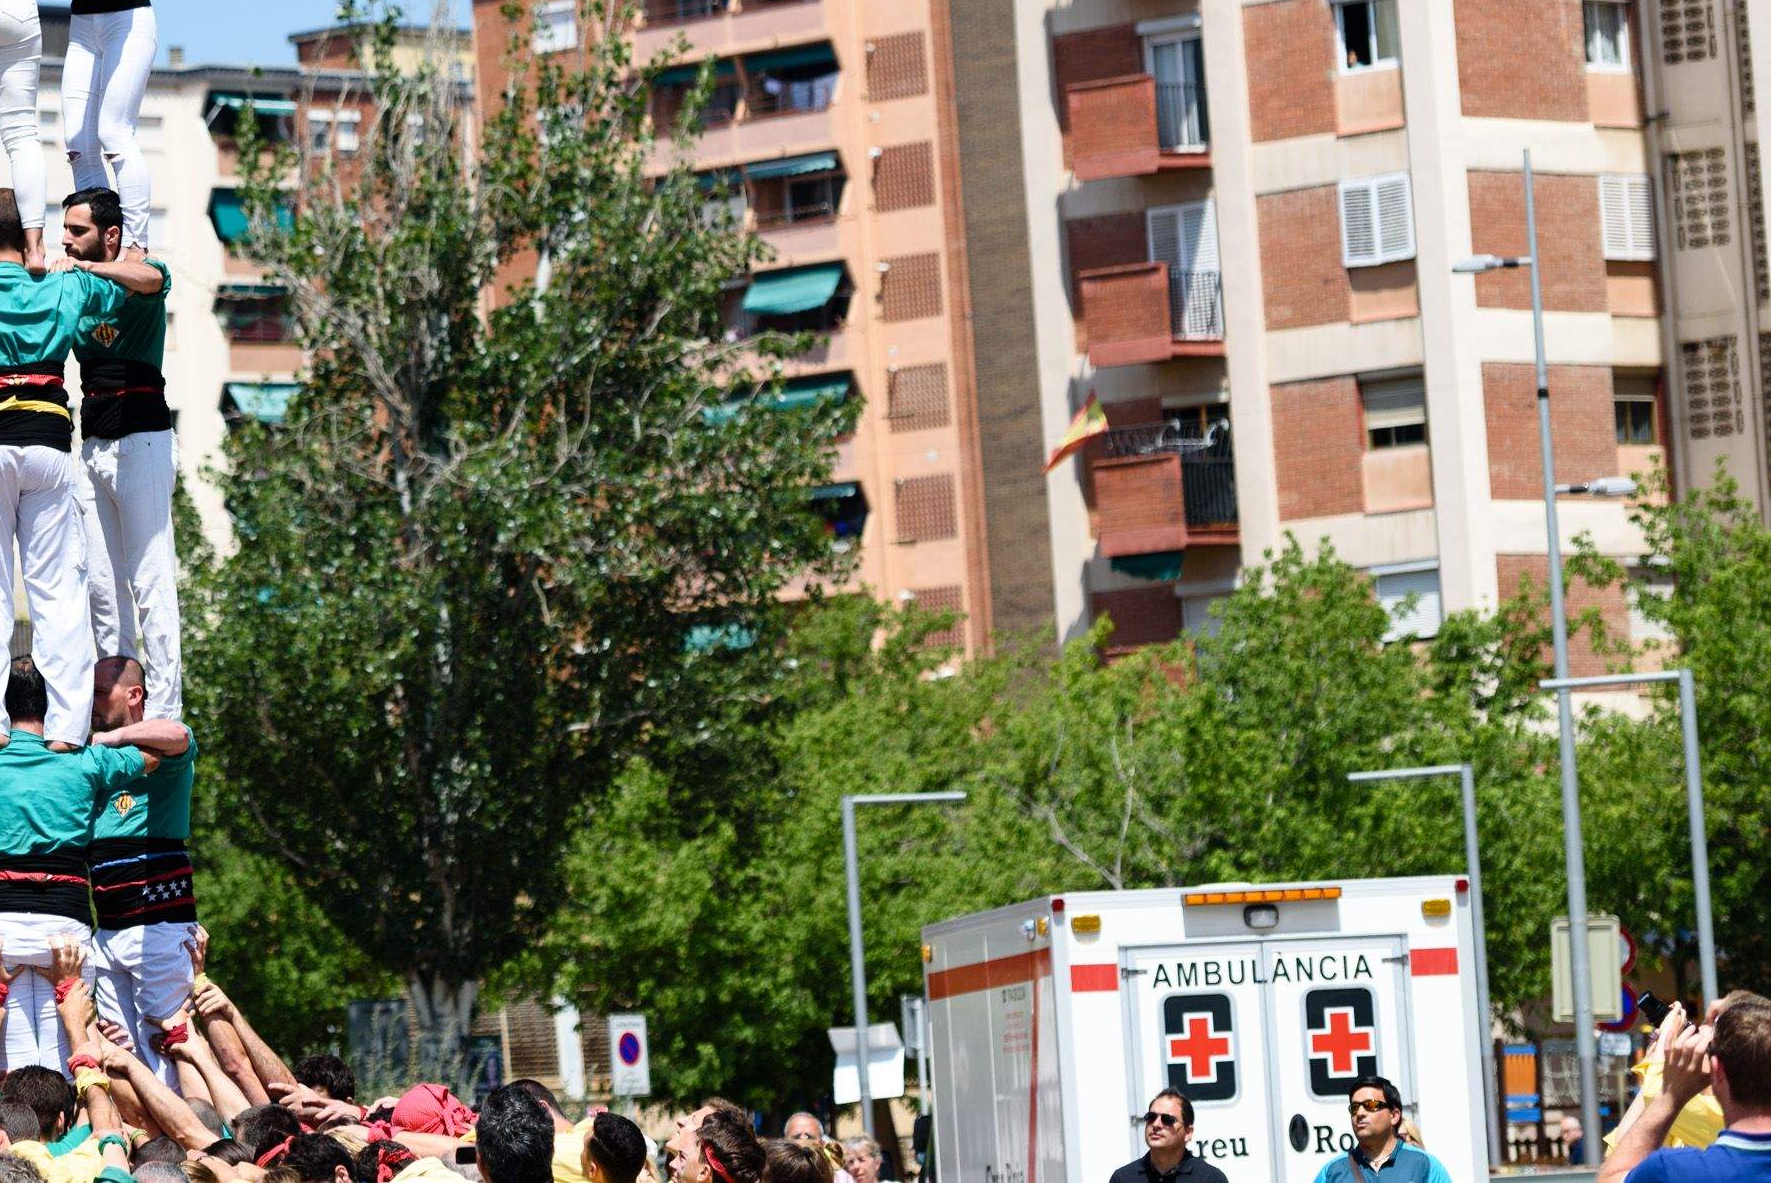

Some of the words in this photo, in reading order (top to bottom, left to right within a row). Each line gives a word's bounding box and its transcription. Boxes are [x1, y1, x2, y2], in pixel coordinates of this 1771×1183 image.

[1153, 952, 1372, 988] AMBULÀNCIA
[1192, 1137, 1249, 1159] reu
[1313, 1125, 1354, 1154] Ro
